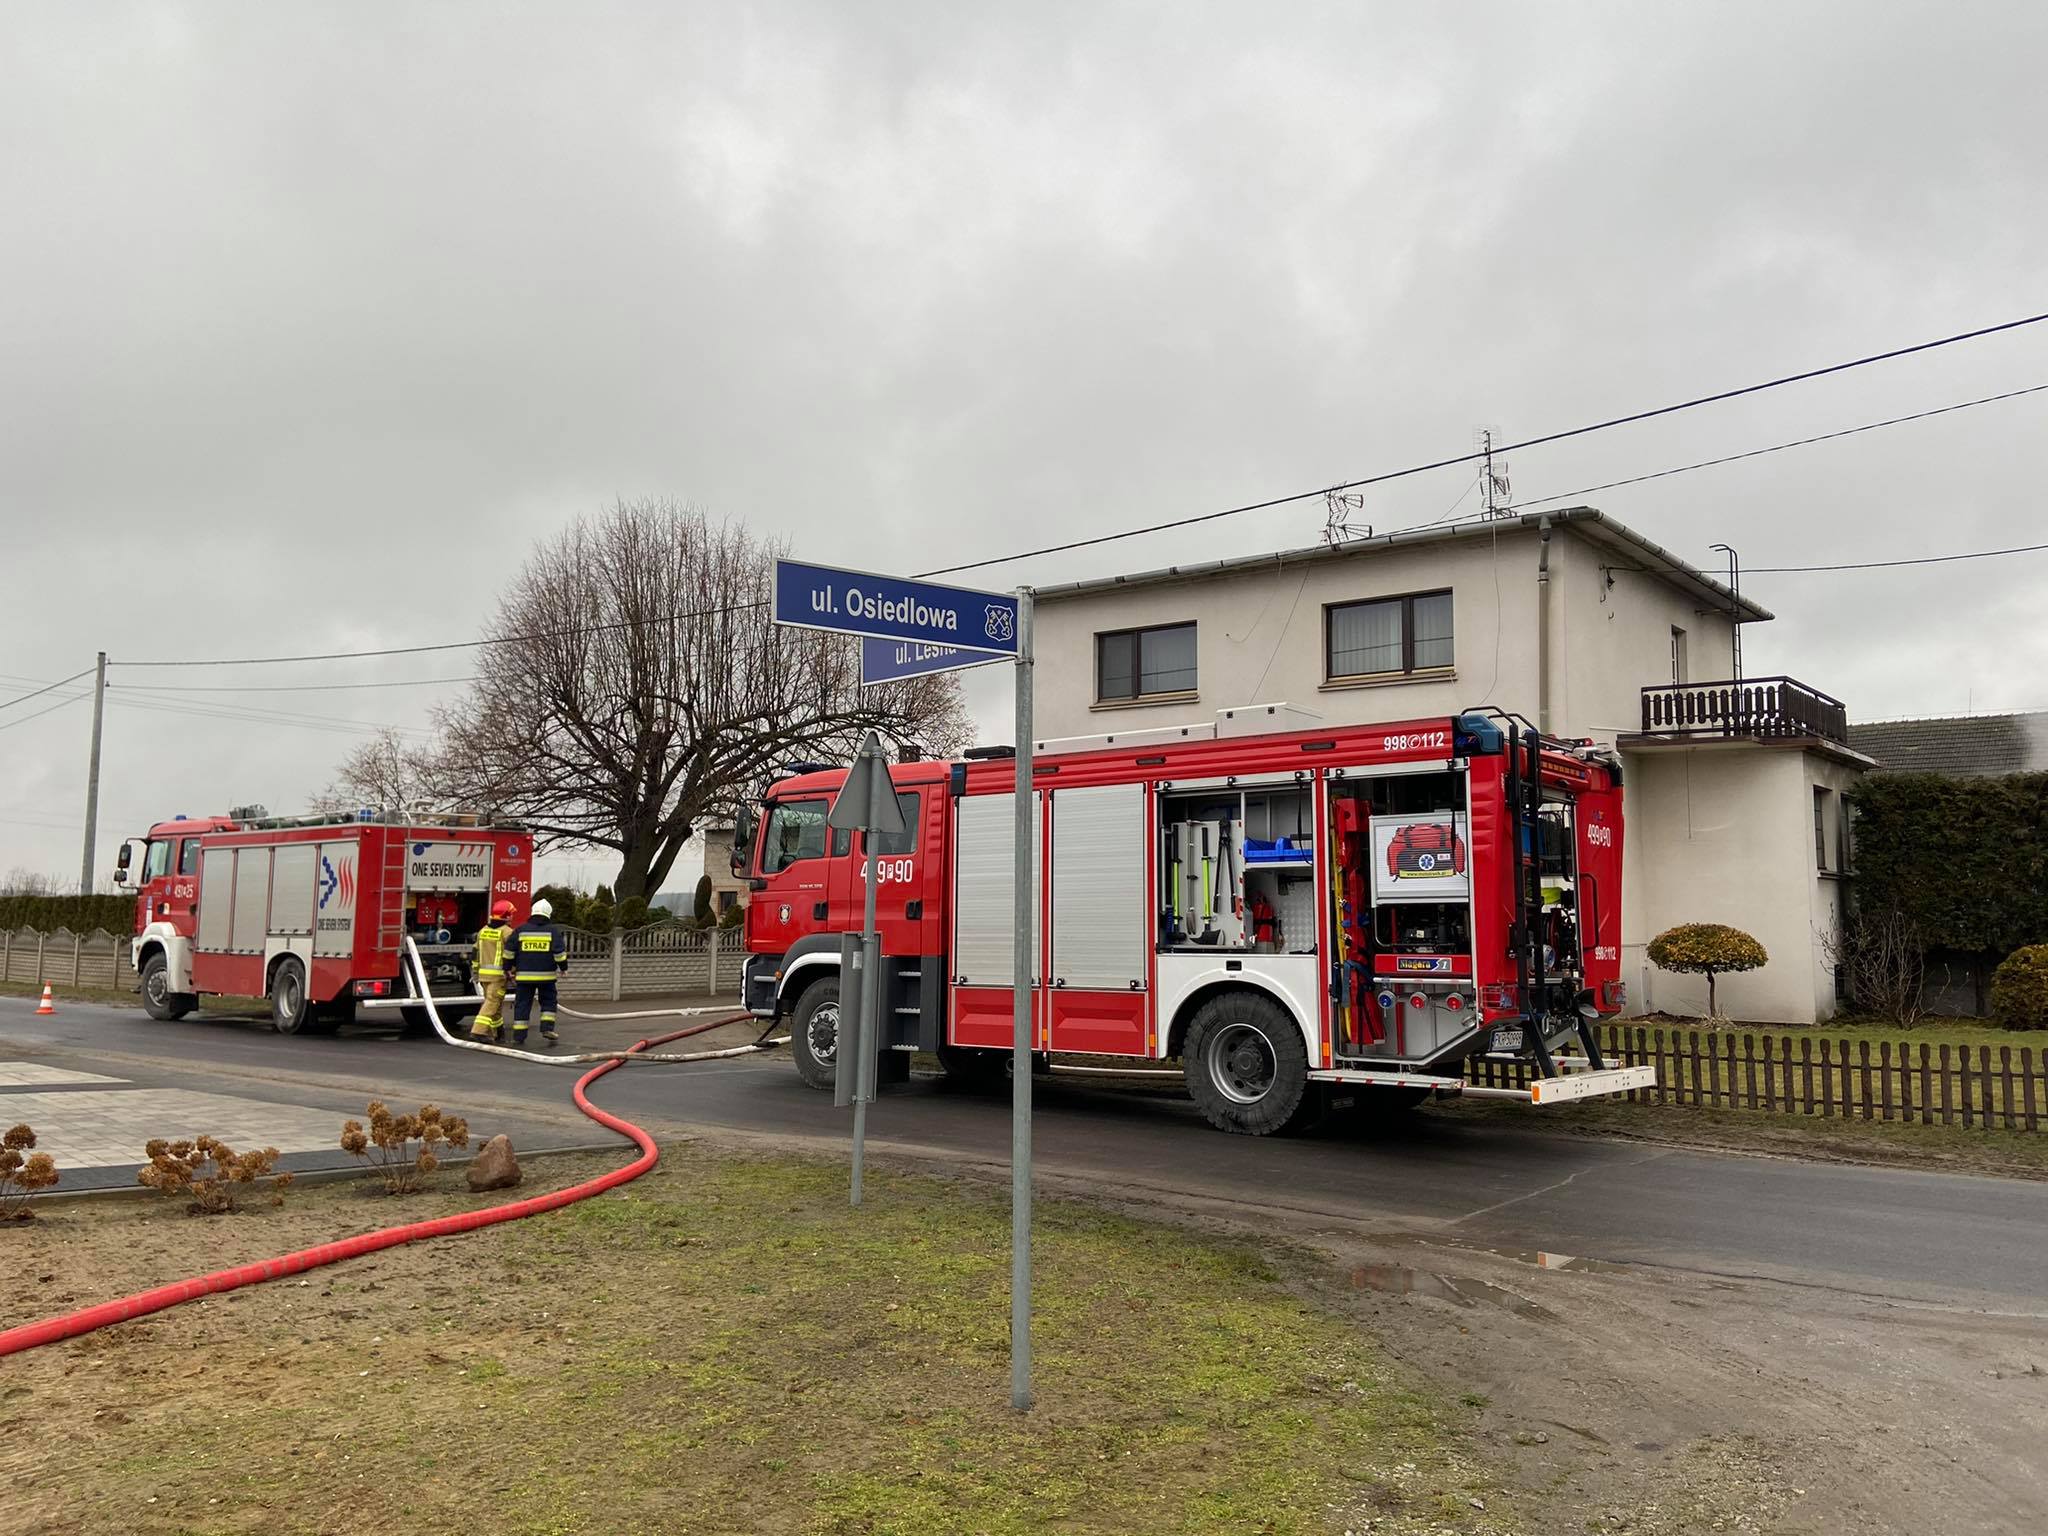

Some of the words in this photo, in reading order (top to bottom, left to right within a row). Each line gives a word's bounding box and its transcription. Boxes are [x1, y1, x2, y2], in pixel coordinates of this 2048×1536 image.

[811, 585, 838, 614] ul.
[845, 588, 957, 631] Osiedlowa
[895, 642, 911, 665] ul.
[1383, 735, 1407, 751] 998
[1421, 731, 1444, 748] 112
[412, 862, 428, 877] ONE
[429, 862, 454, 877] SEVEN
[455, 863, 484, 878] SYSTEM
